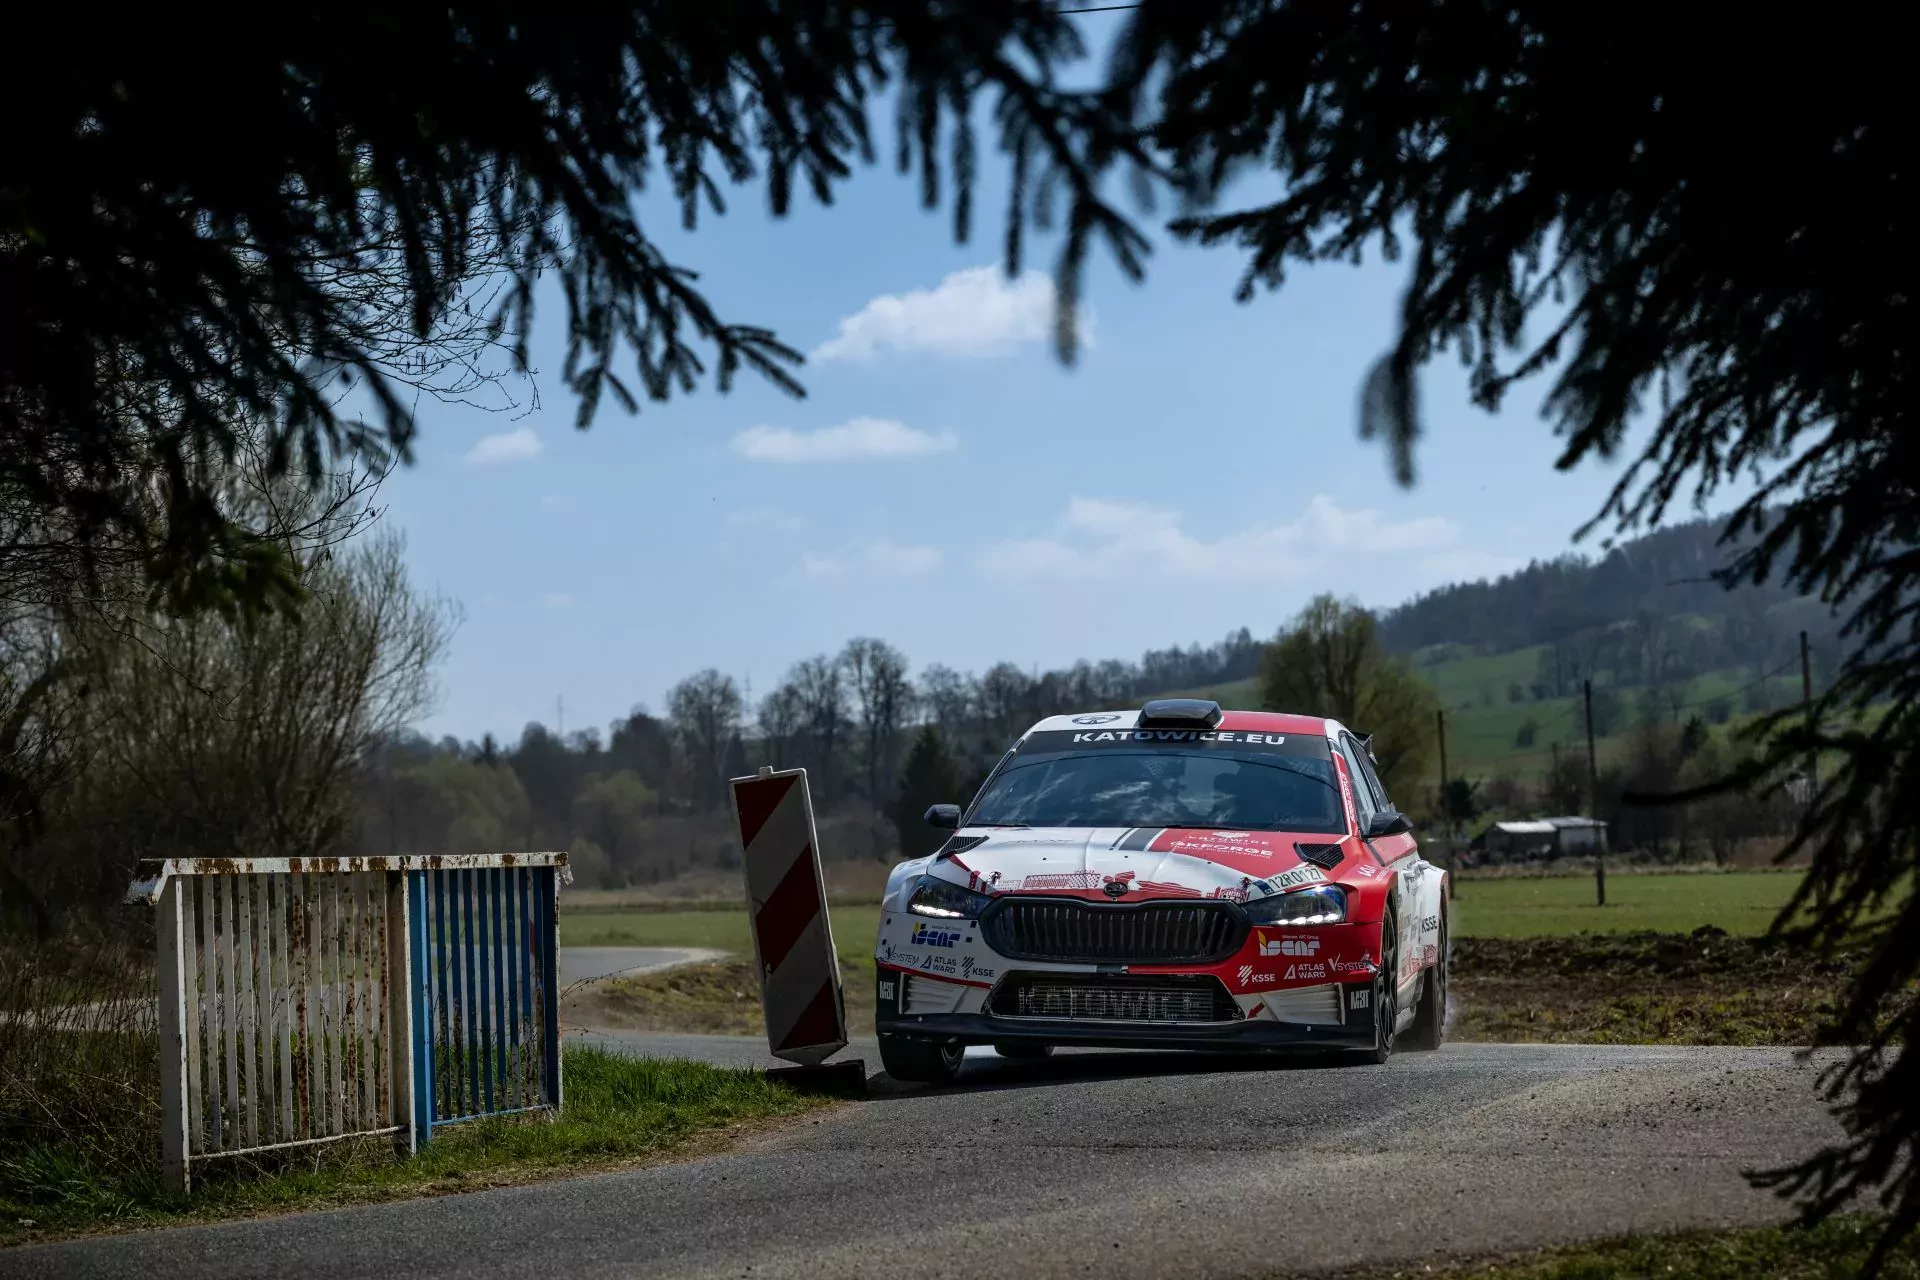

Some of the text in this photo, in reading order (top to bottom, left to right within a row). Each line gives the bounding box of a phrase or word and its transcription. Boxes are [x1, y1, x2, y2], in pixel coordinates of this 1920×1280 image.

[1073, 731, 1285, 745] KATOWICE.EU
[1421, 915, 1438, 934] KSSE
[934, 956, 957, 967] ATLAS
[932, 965, 956, 975] WARD
[972, 967, 995, 978] KSSE
[1297, 963, 1325, 972] ATLAS
[1251, 973, 1276, 983] KSSE
[1298, 971, 1326, 979] WARD
